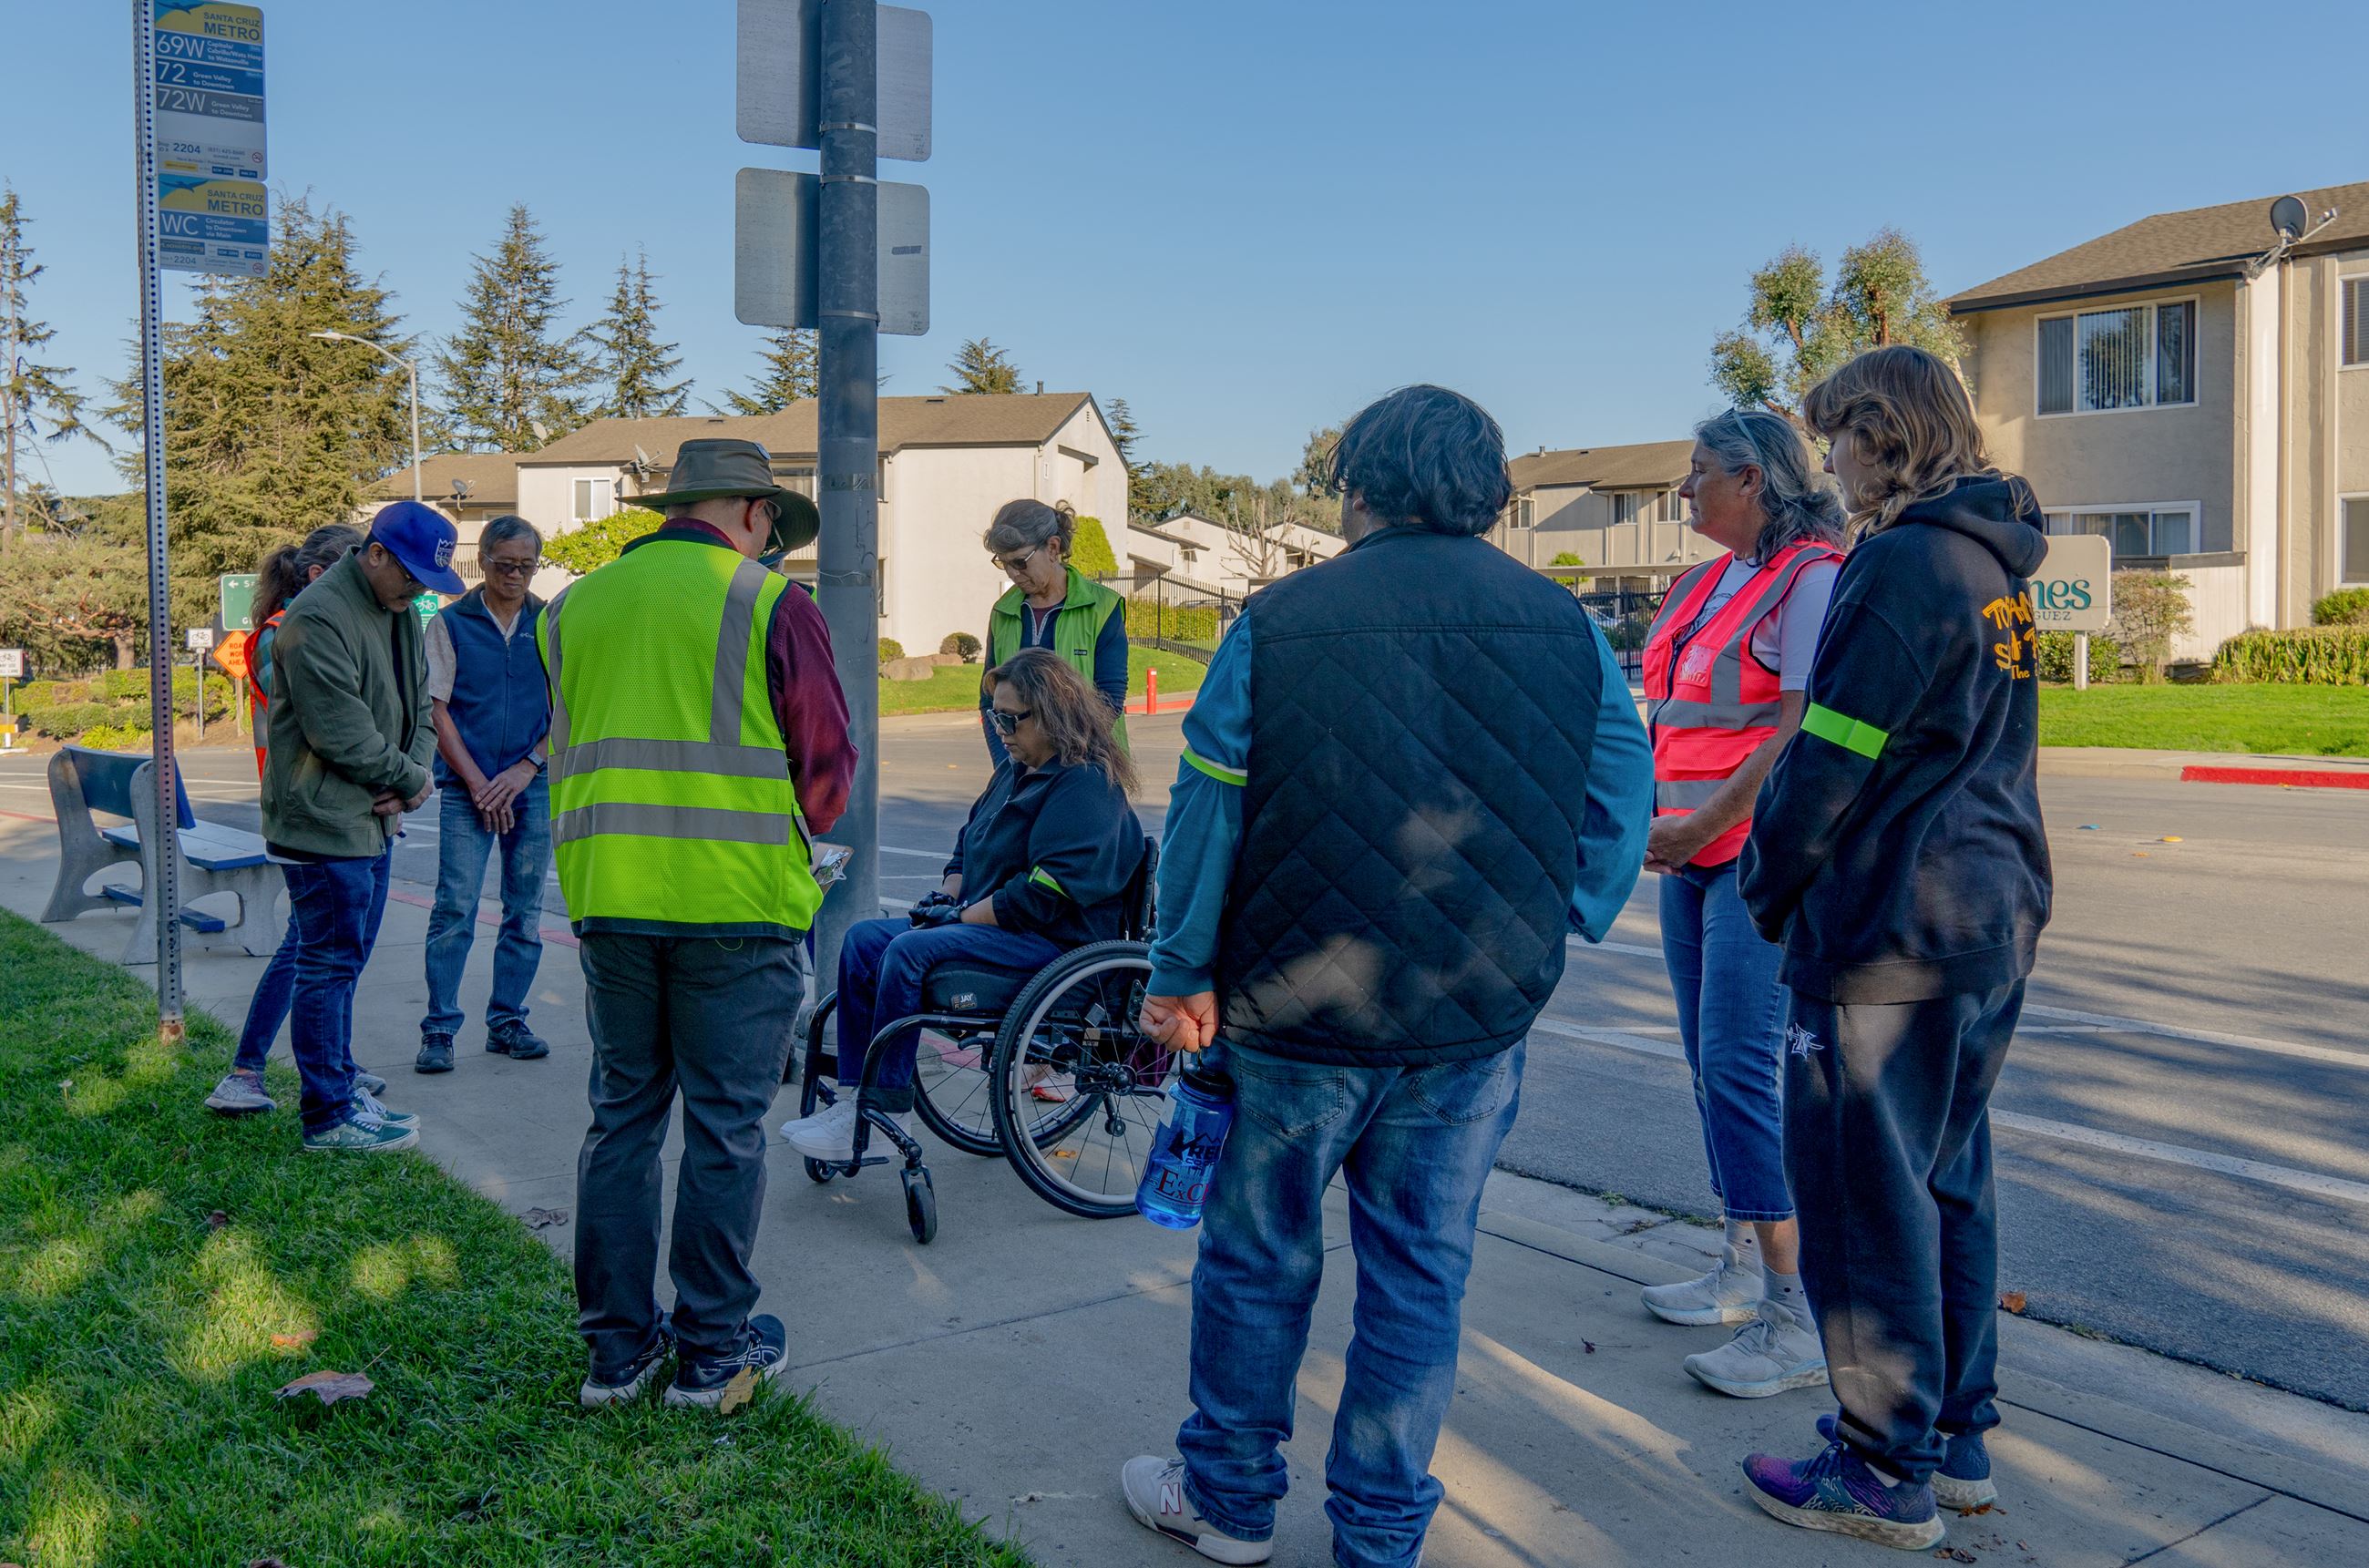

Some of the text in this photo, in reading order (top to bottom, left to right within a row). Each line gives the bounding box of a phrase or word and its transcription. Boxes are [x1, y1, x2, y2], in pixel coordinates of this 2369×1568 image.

[204, 12, 261, 27] SANTA CRUZ
[204, 21, 261, 41] METRO
[157, 35, 205, 58] 69W
[157, 60, 187, 84] 72
[157, 87, 206, 112] 72W
[173, 142, 200, 154] 2204
[207, 189, 264, 202] SANTA CRUZ
[207, 199, 264, 216] METRO
[160, 212, 200, 235] WC
[174, 255, 197, 264] 2204
